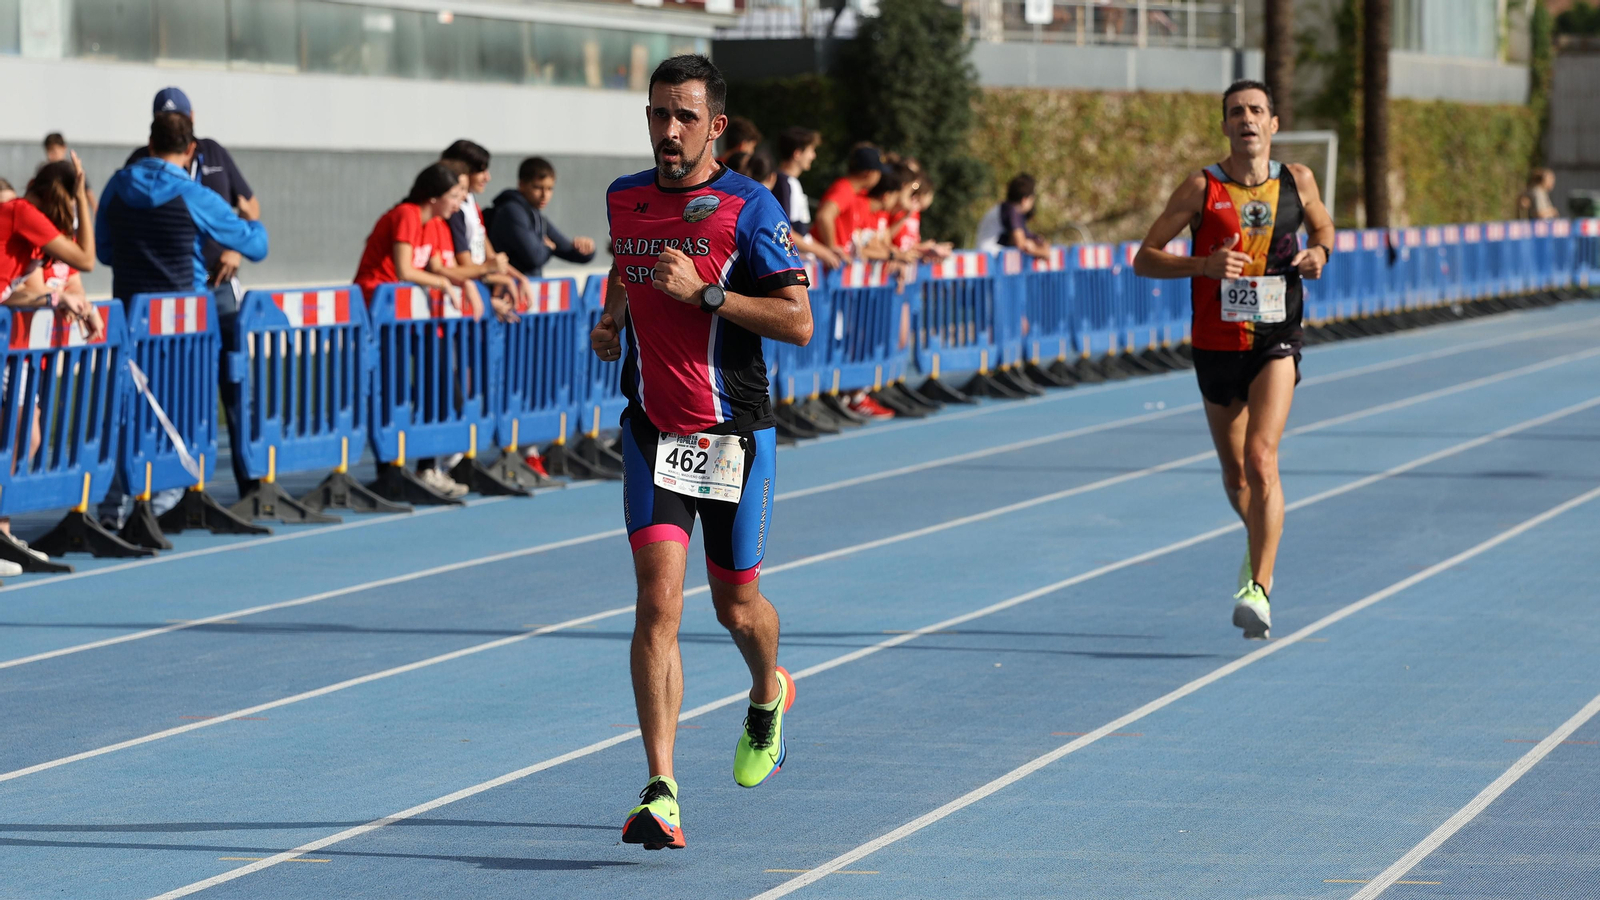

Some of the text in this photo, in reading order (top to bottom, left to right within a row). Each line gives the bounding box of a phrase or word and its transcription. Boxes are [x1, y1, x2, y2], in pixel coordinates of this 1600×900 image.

[614, 237, 710, 256] GADEIRAS
[1228, 289, 1258, 306] 923
[665, 447, 709, 475] 462
[762, 477, 770, 509] SPORT
